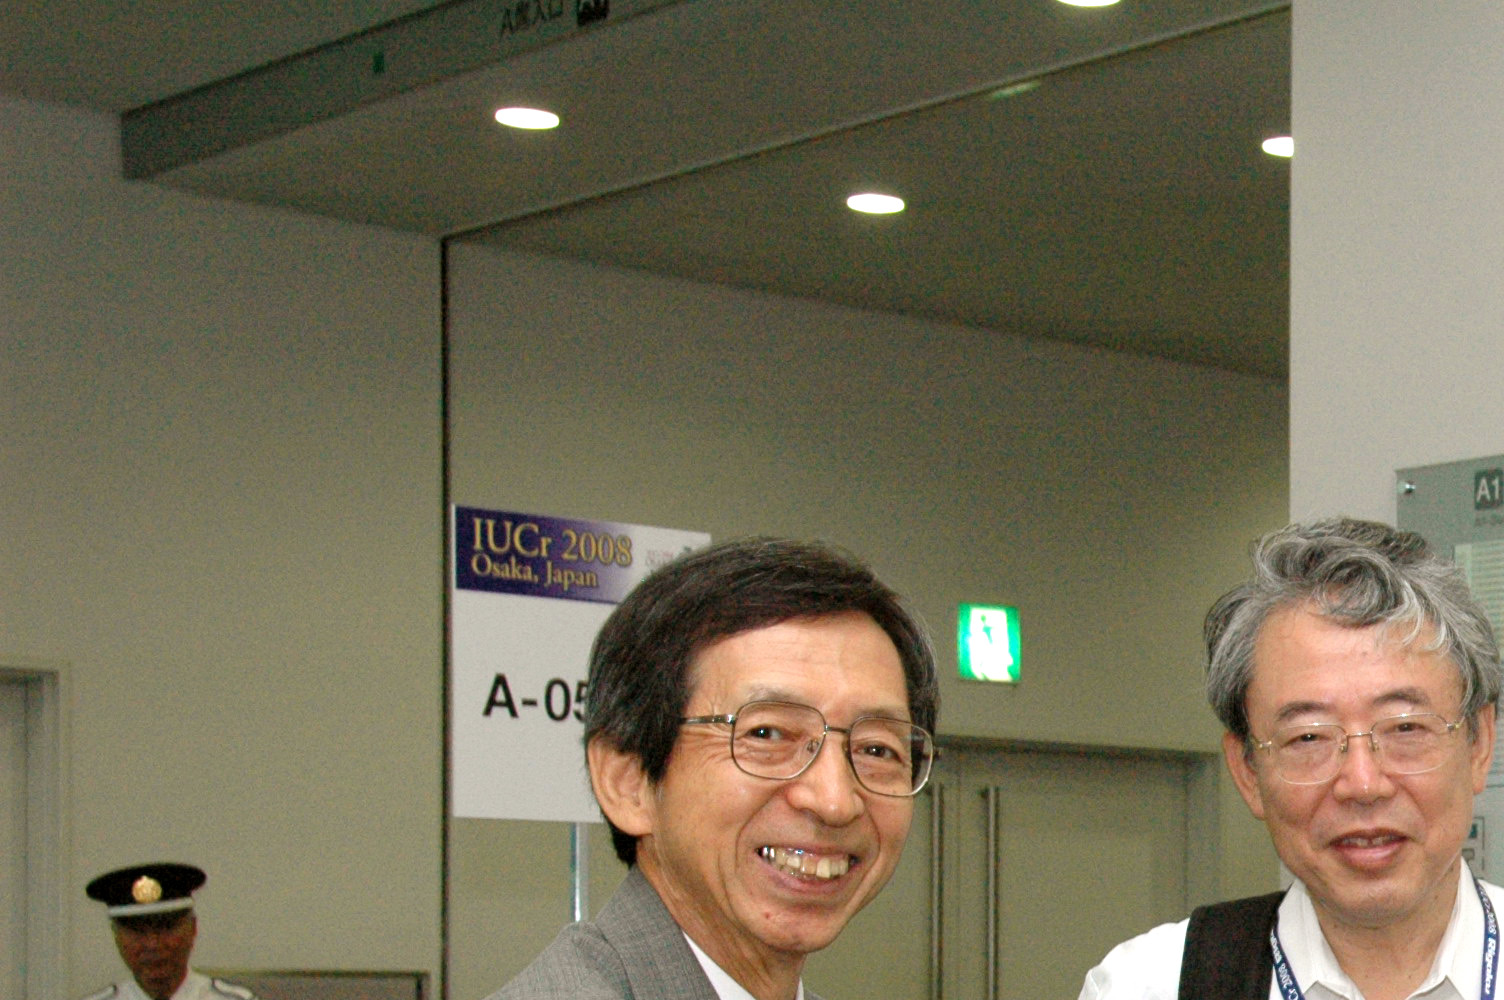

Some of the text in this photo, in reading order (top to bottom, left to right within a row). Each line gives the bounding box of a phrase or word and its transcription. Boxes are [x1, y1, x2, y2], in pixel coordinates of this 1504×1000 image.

[1476, 475, 1500, 503] A1
[472, 517, 552, 558] IUCr
[560, 528, 633, 567] 2008
[471, 552, 598, 591] Osaka, Japan
